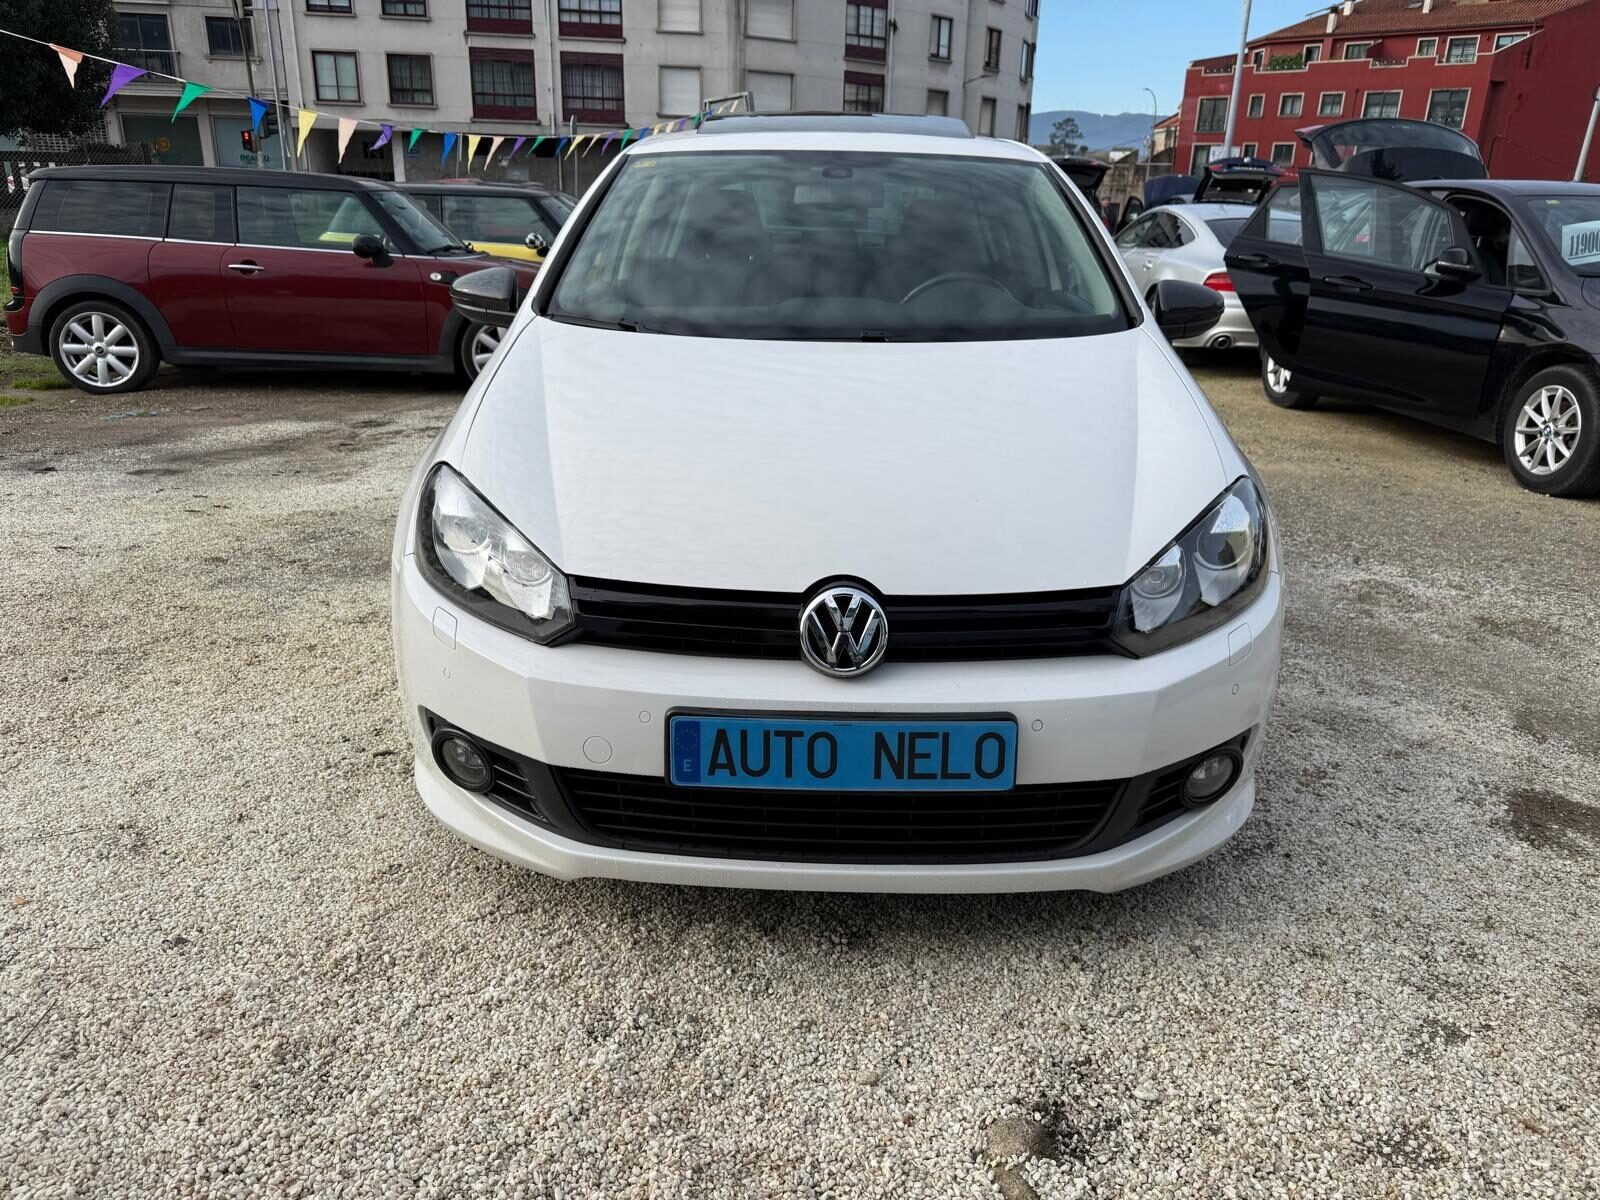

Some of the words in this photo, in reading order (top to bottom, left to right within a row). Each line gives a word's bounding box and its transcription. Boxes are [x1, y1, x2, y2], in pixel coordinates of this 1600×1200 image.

[803, 590, 885, 673] VW
[683, 759, 693, 772] E
[707, 728, 838, 779] AUTO
[874, 731, 1006, 780] NELO
